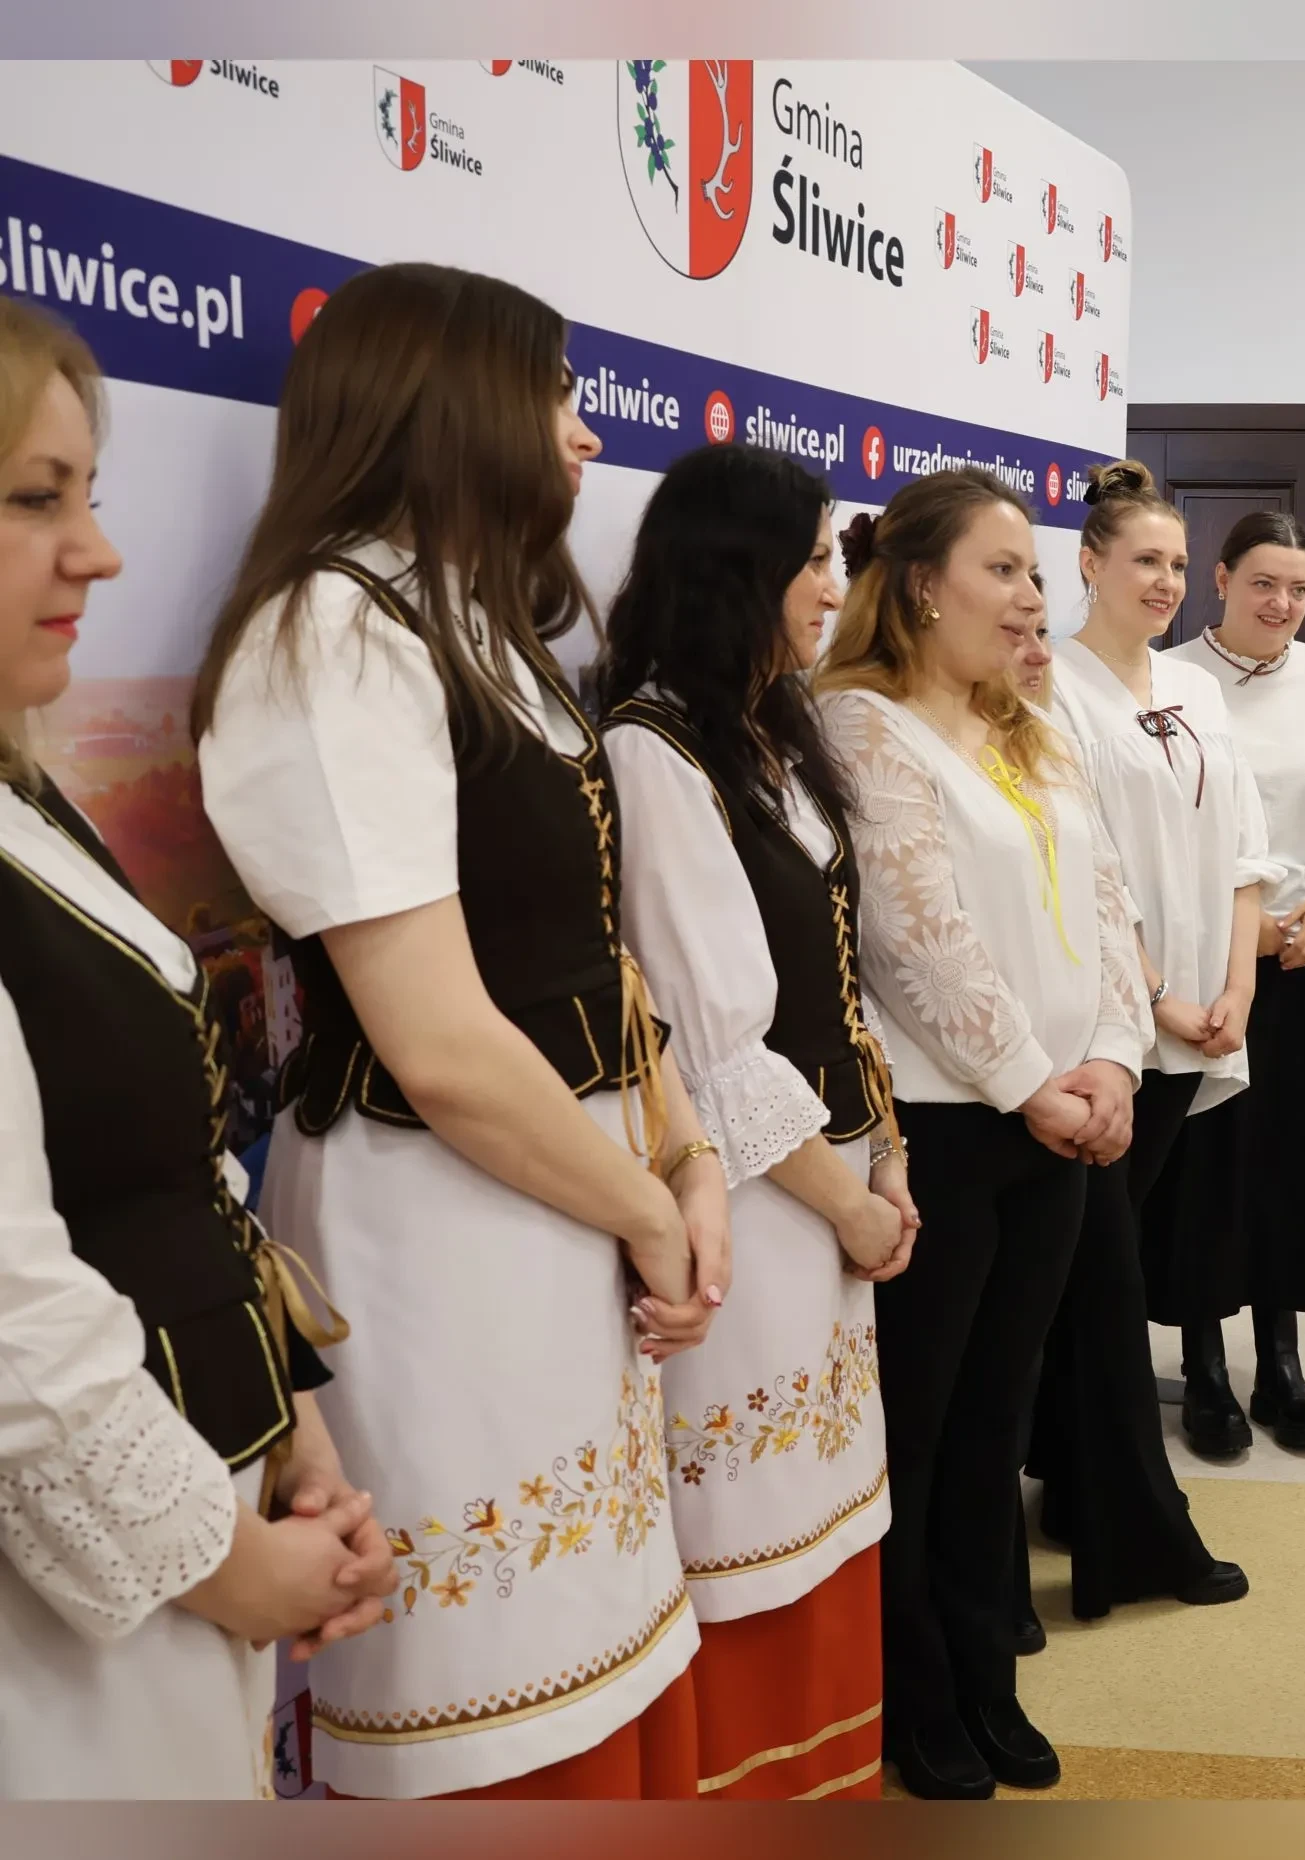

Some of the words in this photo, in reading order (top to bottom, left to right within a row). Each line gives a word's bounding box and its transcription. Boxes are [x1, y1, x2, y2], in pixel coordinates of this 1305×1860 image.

[518, 60, 564, 85] wice
[429, 112, 465, 140] Gmina
[772, 78, 863, 170] Gmina
[430, 134, 483, 176] Śliwice
[772, 154, 905, 288] Śliwice
[746, 405, 844, 471] sliwice.pl
